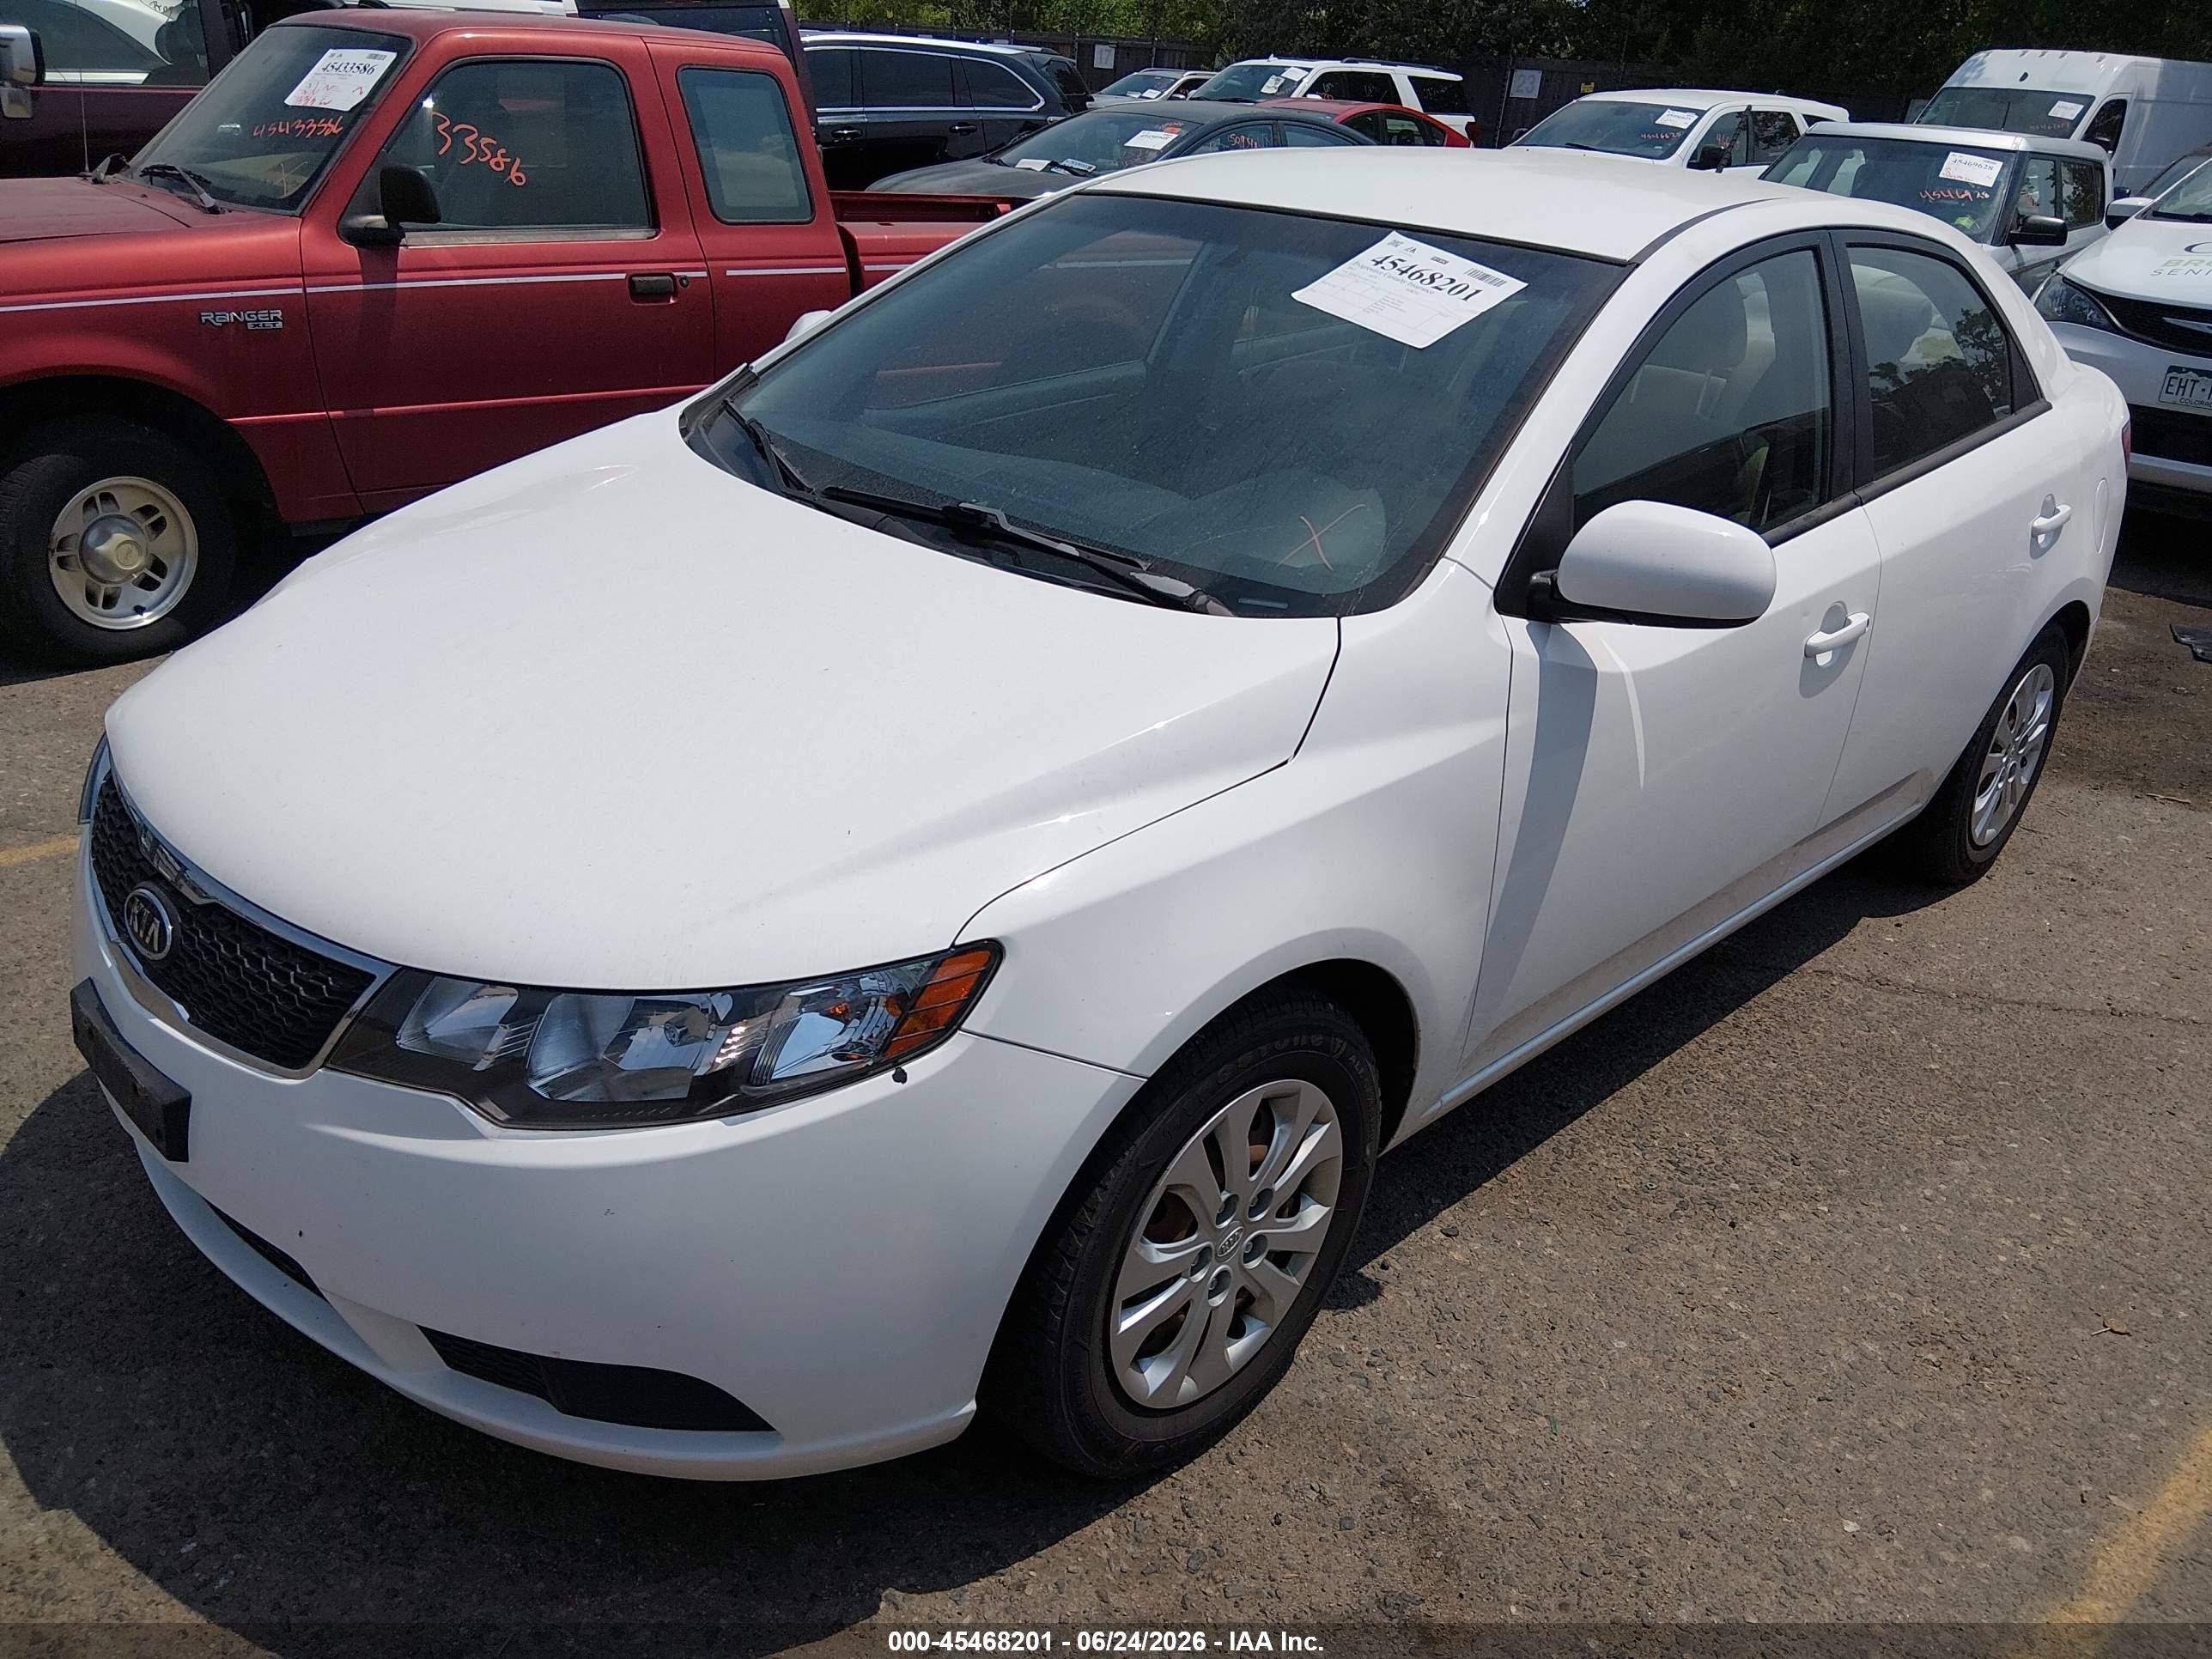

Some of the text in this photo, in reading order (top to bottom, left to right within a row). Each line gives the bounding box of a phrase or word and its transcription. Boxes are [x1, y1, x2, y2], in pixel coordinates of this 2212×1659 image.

[321, 62, 378, 76] 45433586
[1517, 74, 1535, 94] 23
[431, 110, 526, 186] 33586
[1370, 254, 1483, 302] 45468201
[200, 309, 283, 326] RANGER
